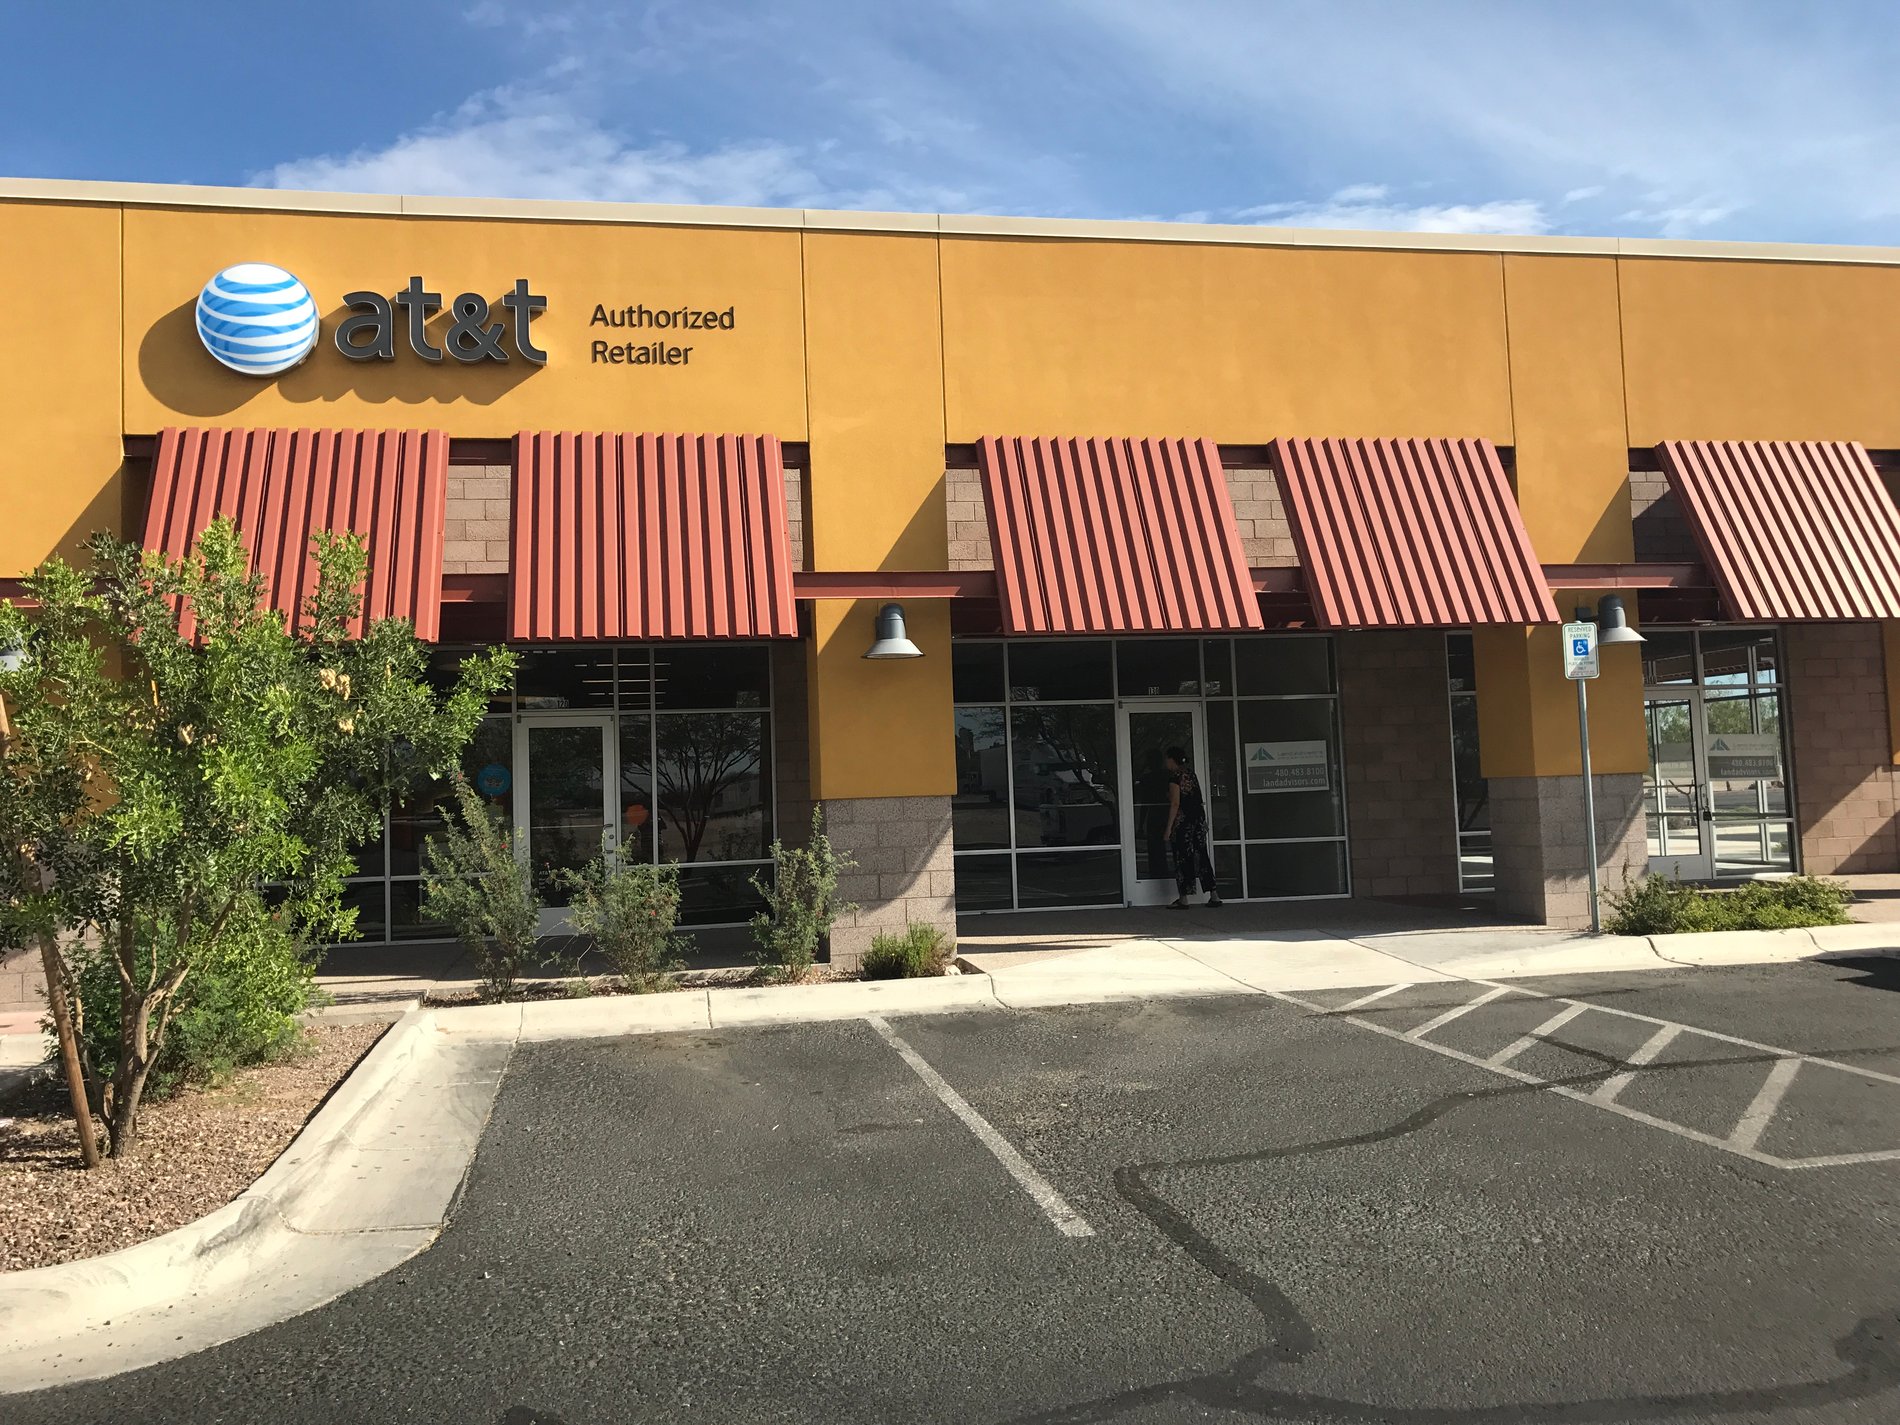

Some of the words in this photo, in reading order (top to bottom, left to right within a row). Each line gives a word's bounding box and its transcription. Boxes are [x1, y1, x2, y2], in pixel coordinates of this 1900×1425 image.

[335, 276, 548, 366] at&t
[589, 303, 735, 330] Authorized
[591, 340, 694, 365] Retailer
